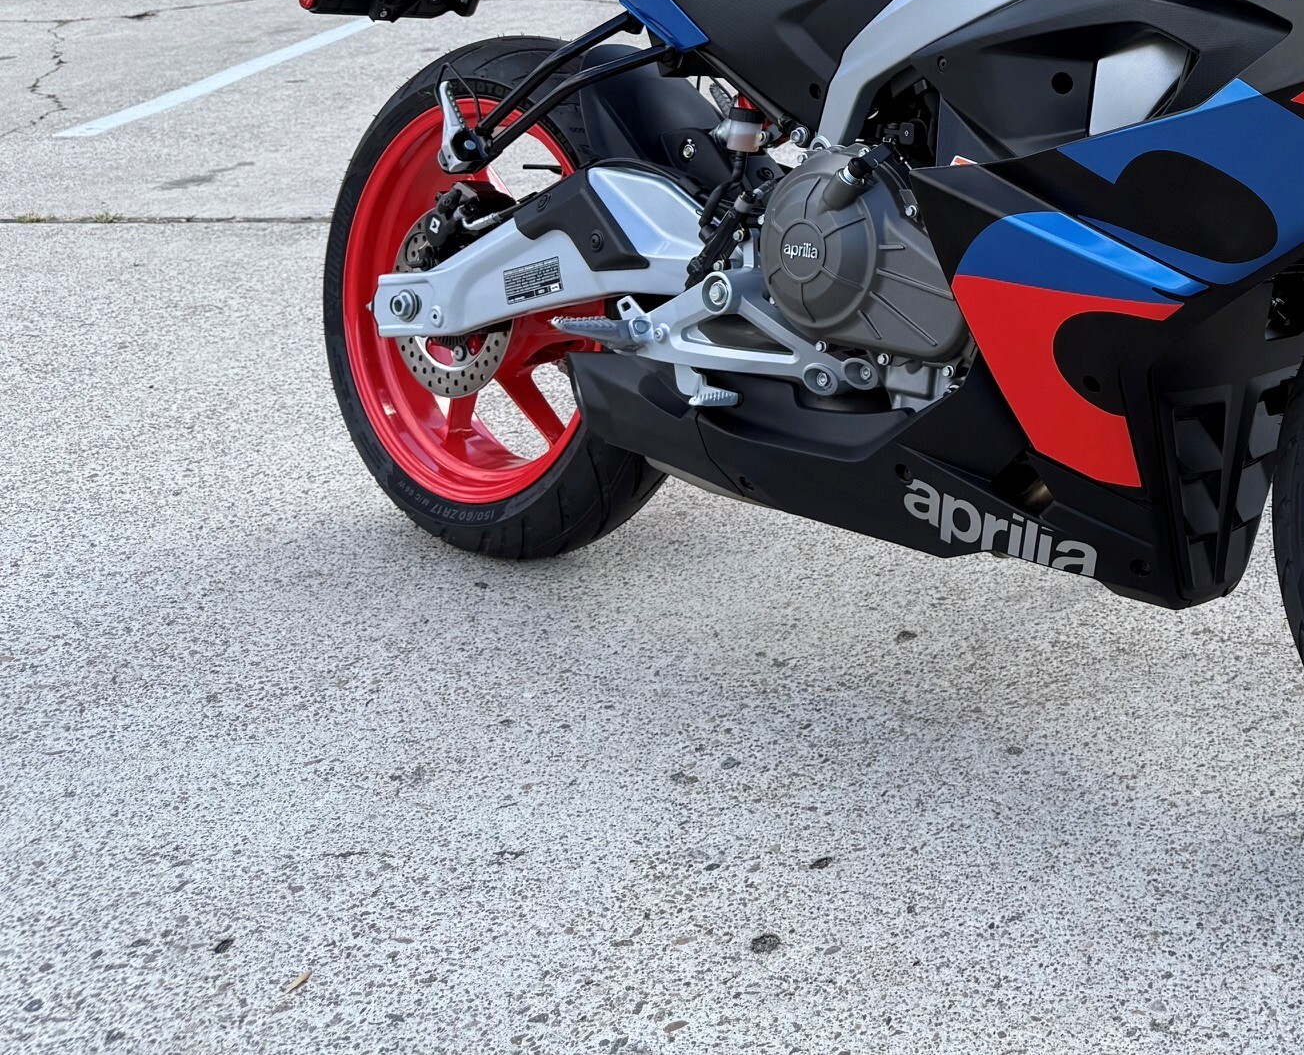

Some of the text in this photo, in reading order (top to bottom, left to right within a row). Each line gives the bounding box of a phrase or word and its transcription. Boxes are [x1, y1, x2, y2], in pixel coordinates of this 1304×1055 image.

[783, 242, 818, 259] aprilia
[430, 503, 457, 520] ZR17
[458, 508, 495, 522] 150/60
[904, 479, 1098, 577] aprilia
